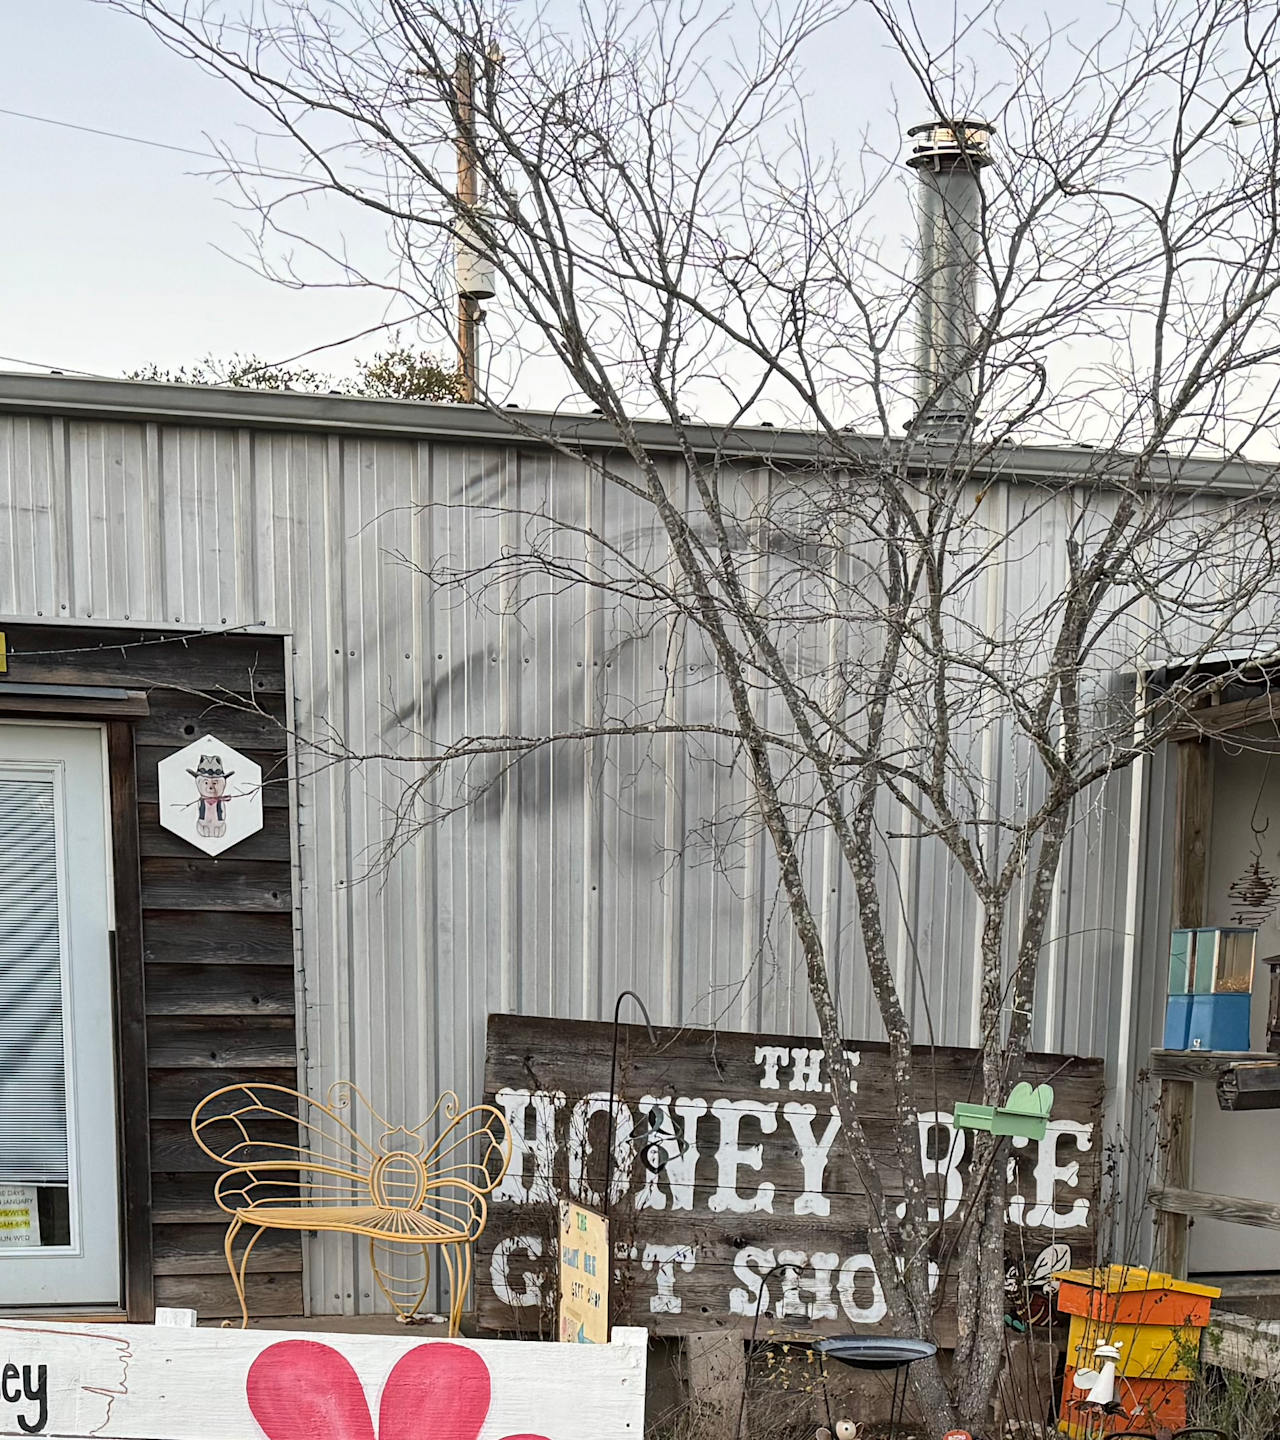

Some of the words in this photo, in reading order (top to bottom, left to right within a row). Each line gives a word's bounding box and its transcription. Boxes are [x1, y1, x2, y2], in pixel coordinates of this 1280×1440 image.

[491, 1087, 840, 1217] HONEY
[896, 1111, 1094, 1229] BE
[729, 1246, 940, 1324] SHO
